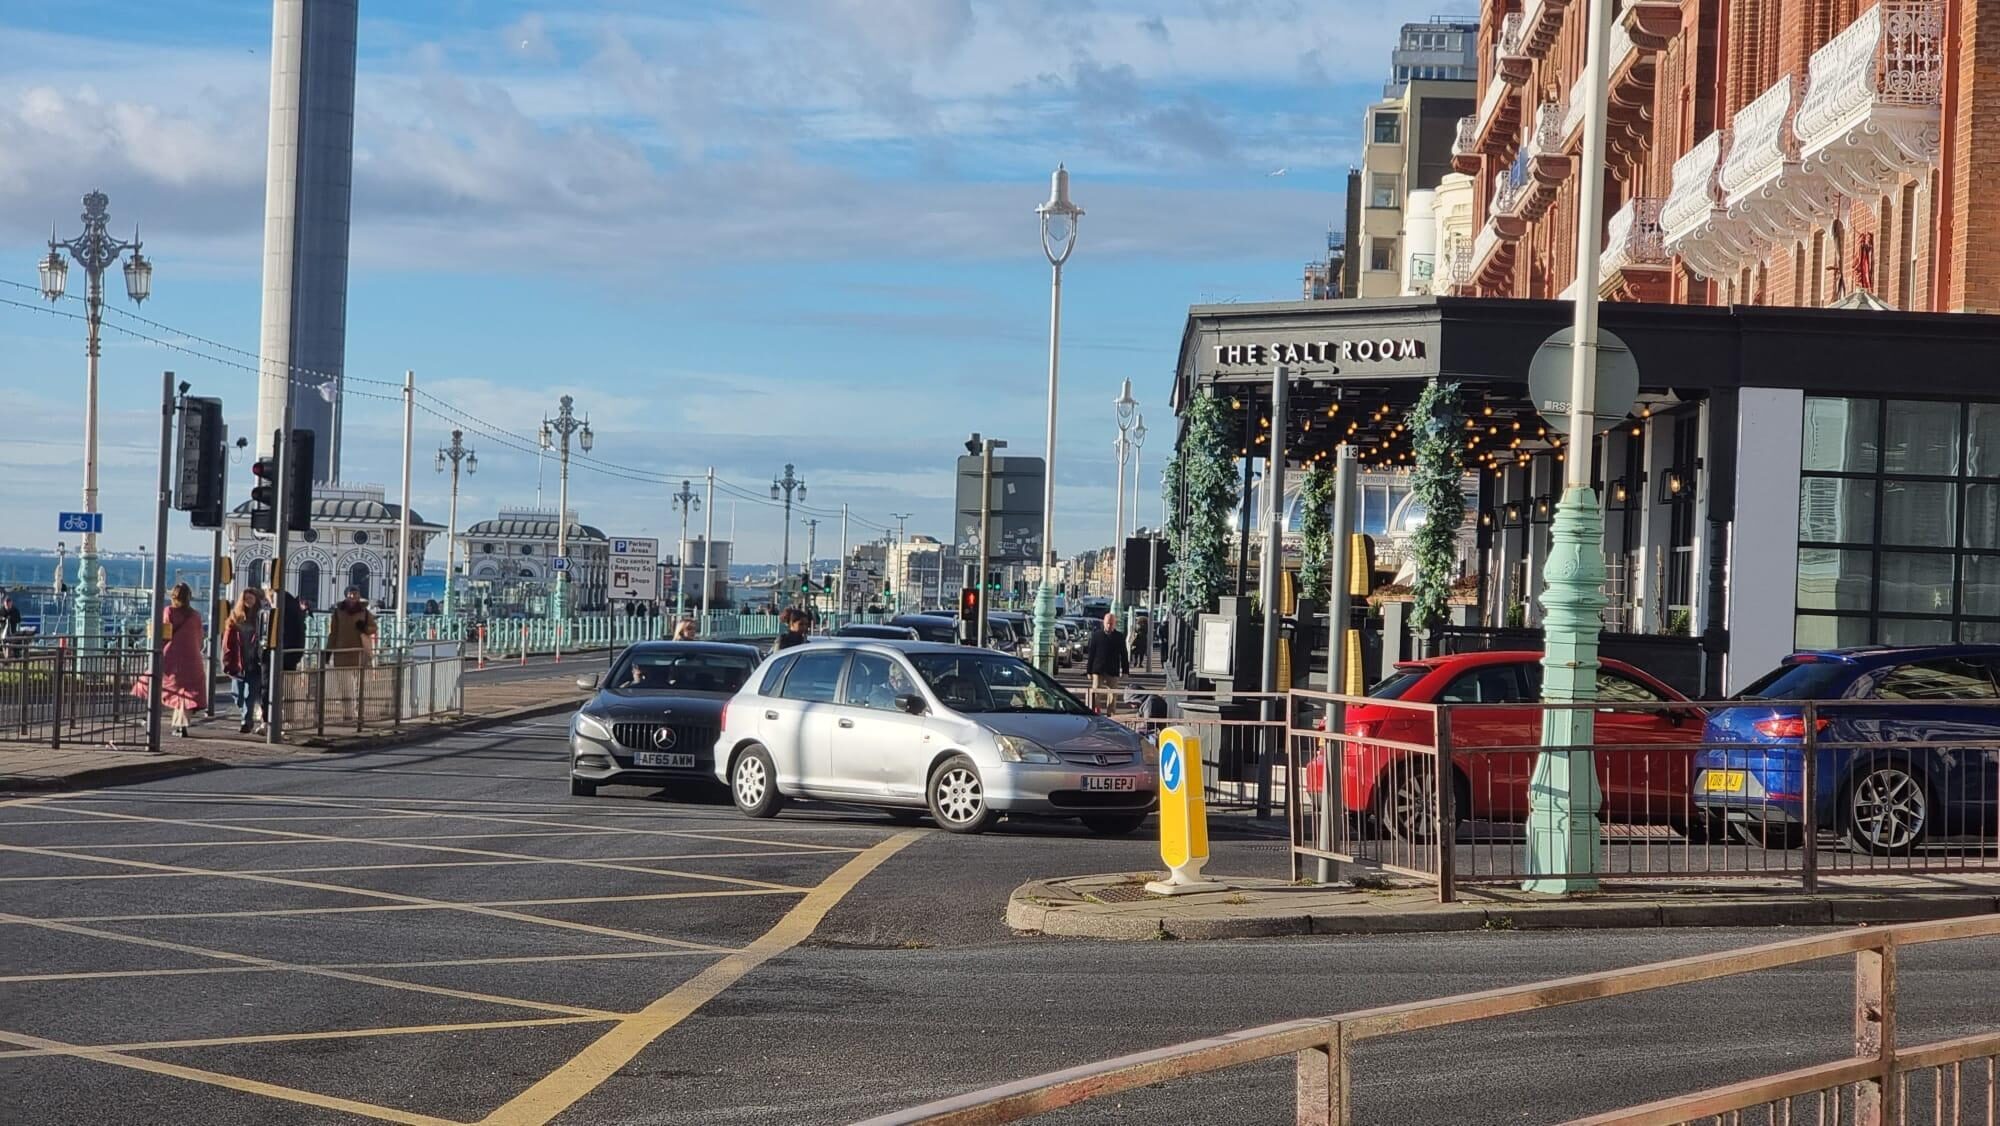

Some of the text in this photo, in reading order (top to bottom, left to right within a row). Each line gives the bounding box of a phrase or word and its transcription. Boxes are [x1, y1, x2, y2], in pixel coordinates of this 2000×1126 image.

[1213, 338, 1418, 364] THE SALT ROOM
[1345, 447, 1358, 457] 13
[642, 754, 670, 764] AF65
[1090, 778, 1133, 789] LL51 EPJ
